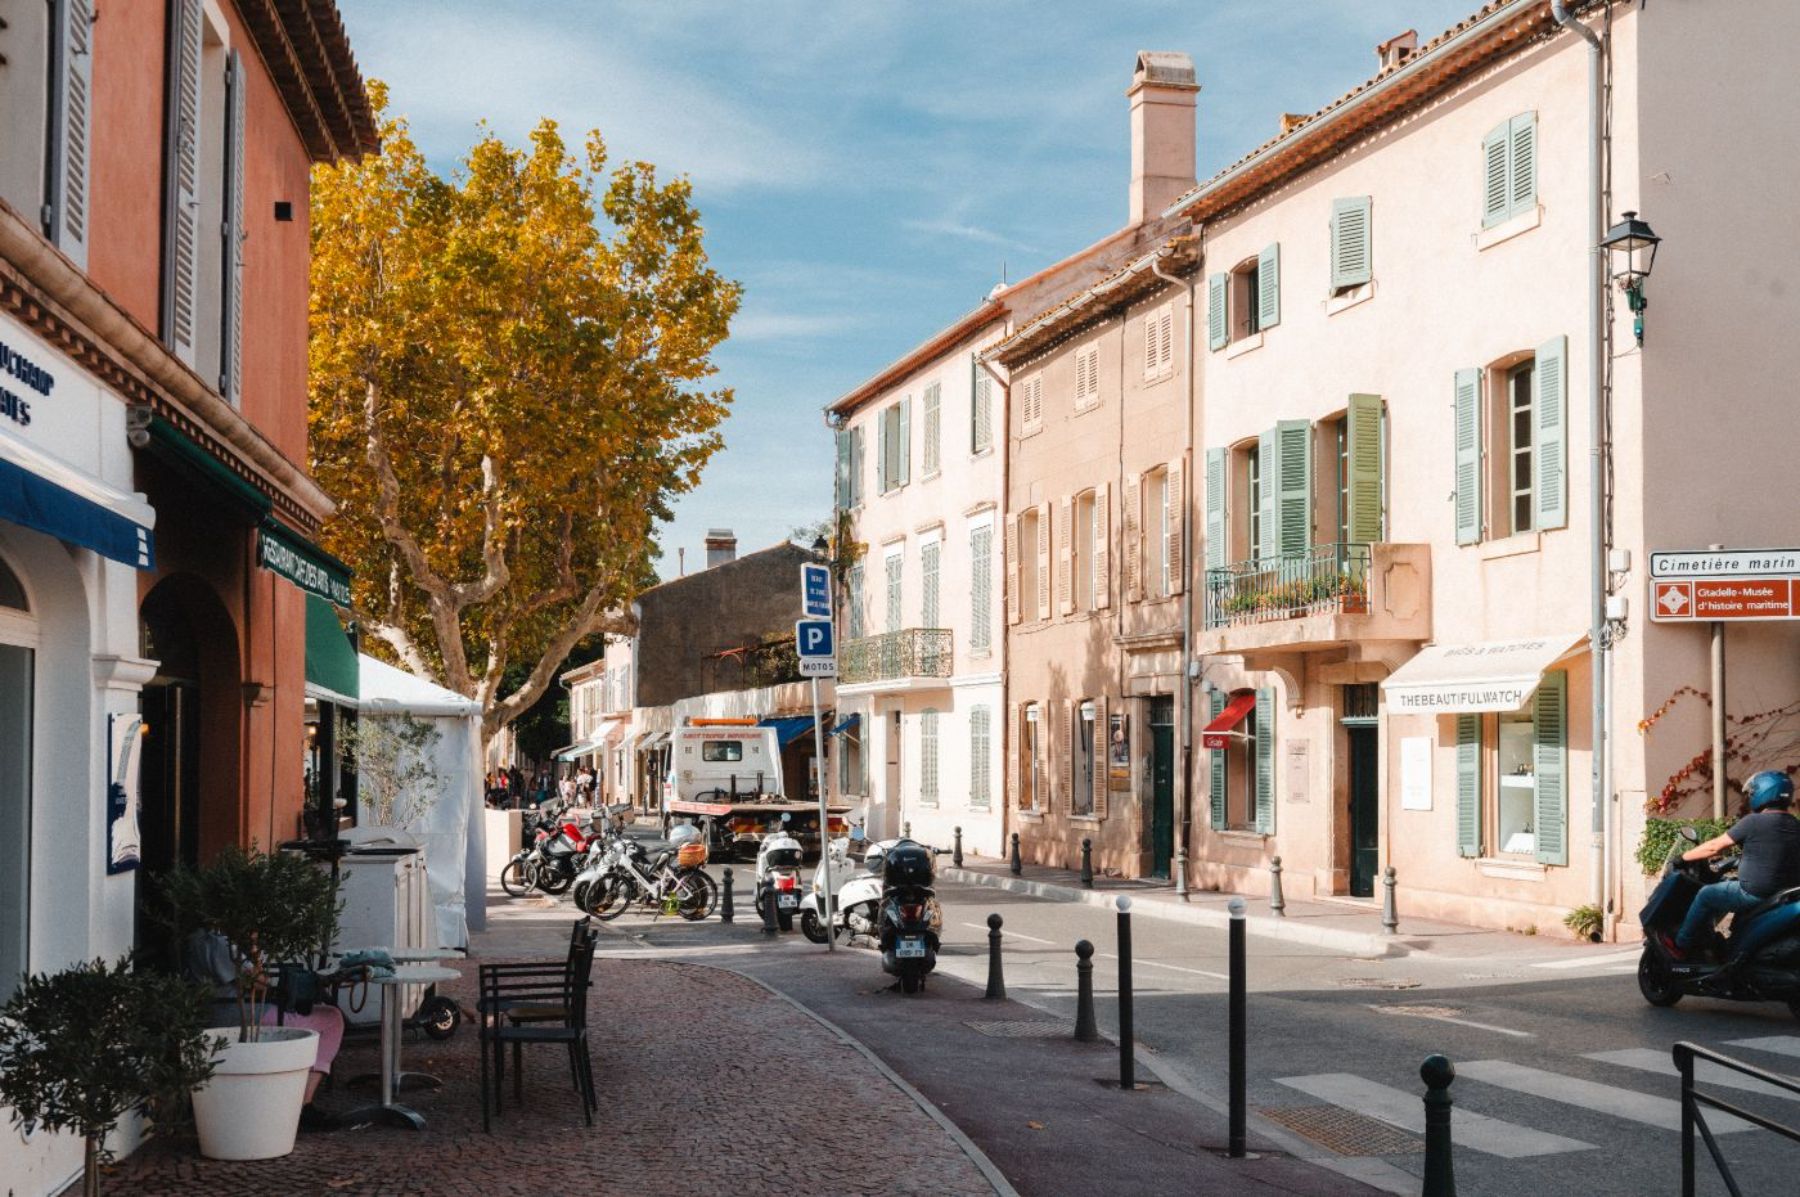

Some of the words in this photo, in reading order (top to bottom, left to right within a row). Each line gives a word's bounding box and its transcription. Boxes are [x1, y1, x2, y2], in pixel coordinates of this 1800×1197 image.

[1659, 558, 1740, 572] Cimetière
[1749, 556, 1796, 570] marin
[1746, 600, 1789, 609] maritime
[807, 627, 824, 650] P
[803, 663, 834, 671] MOTOS
[1400, 690, 1522, 706] THEBEAUTIFULWATCH
